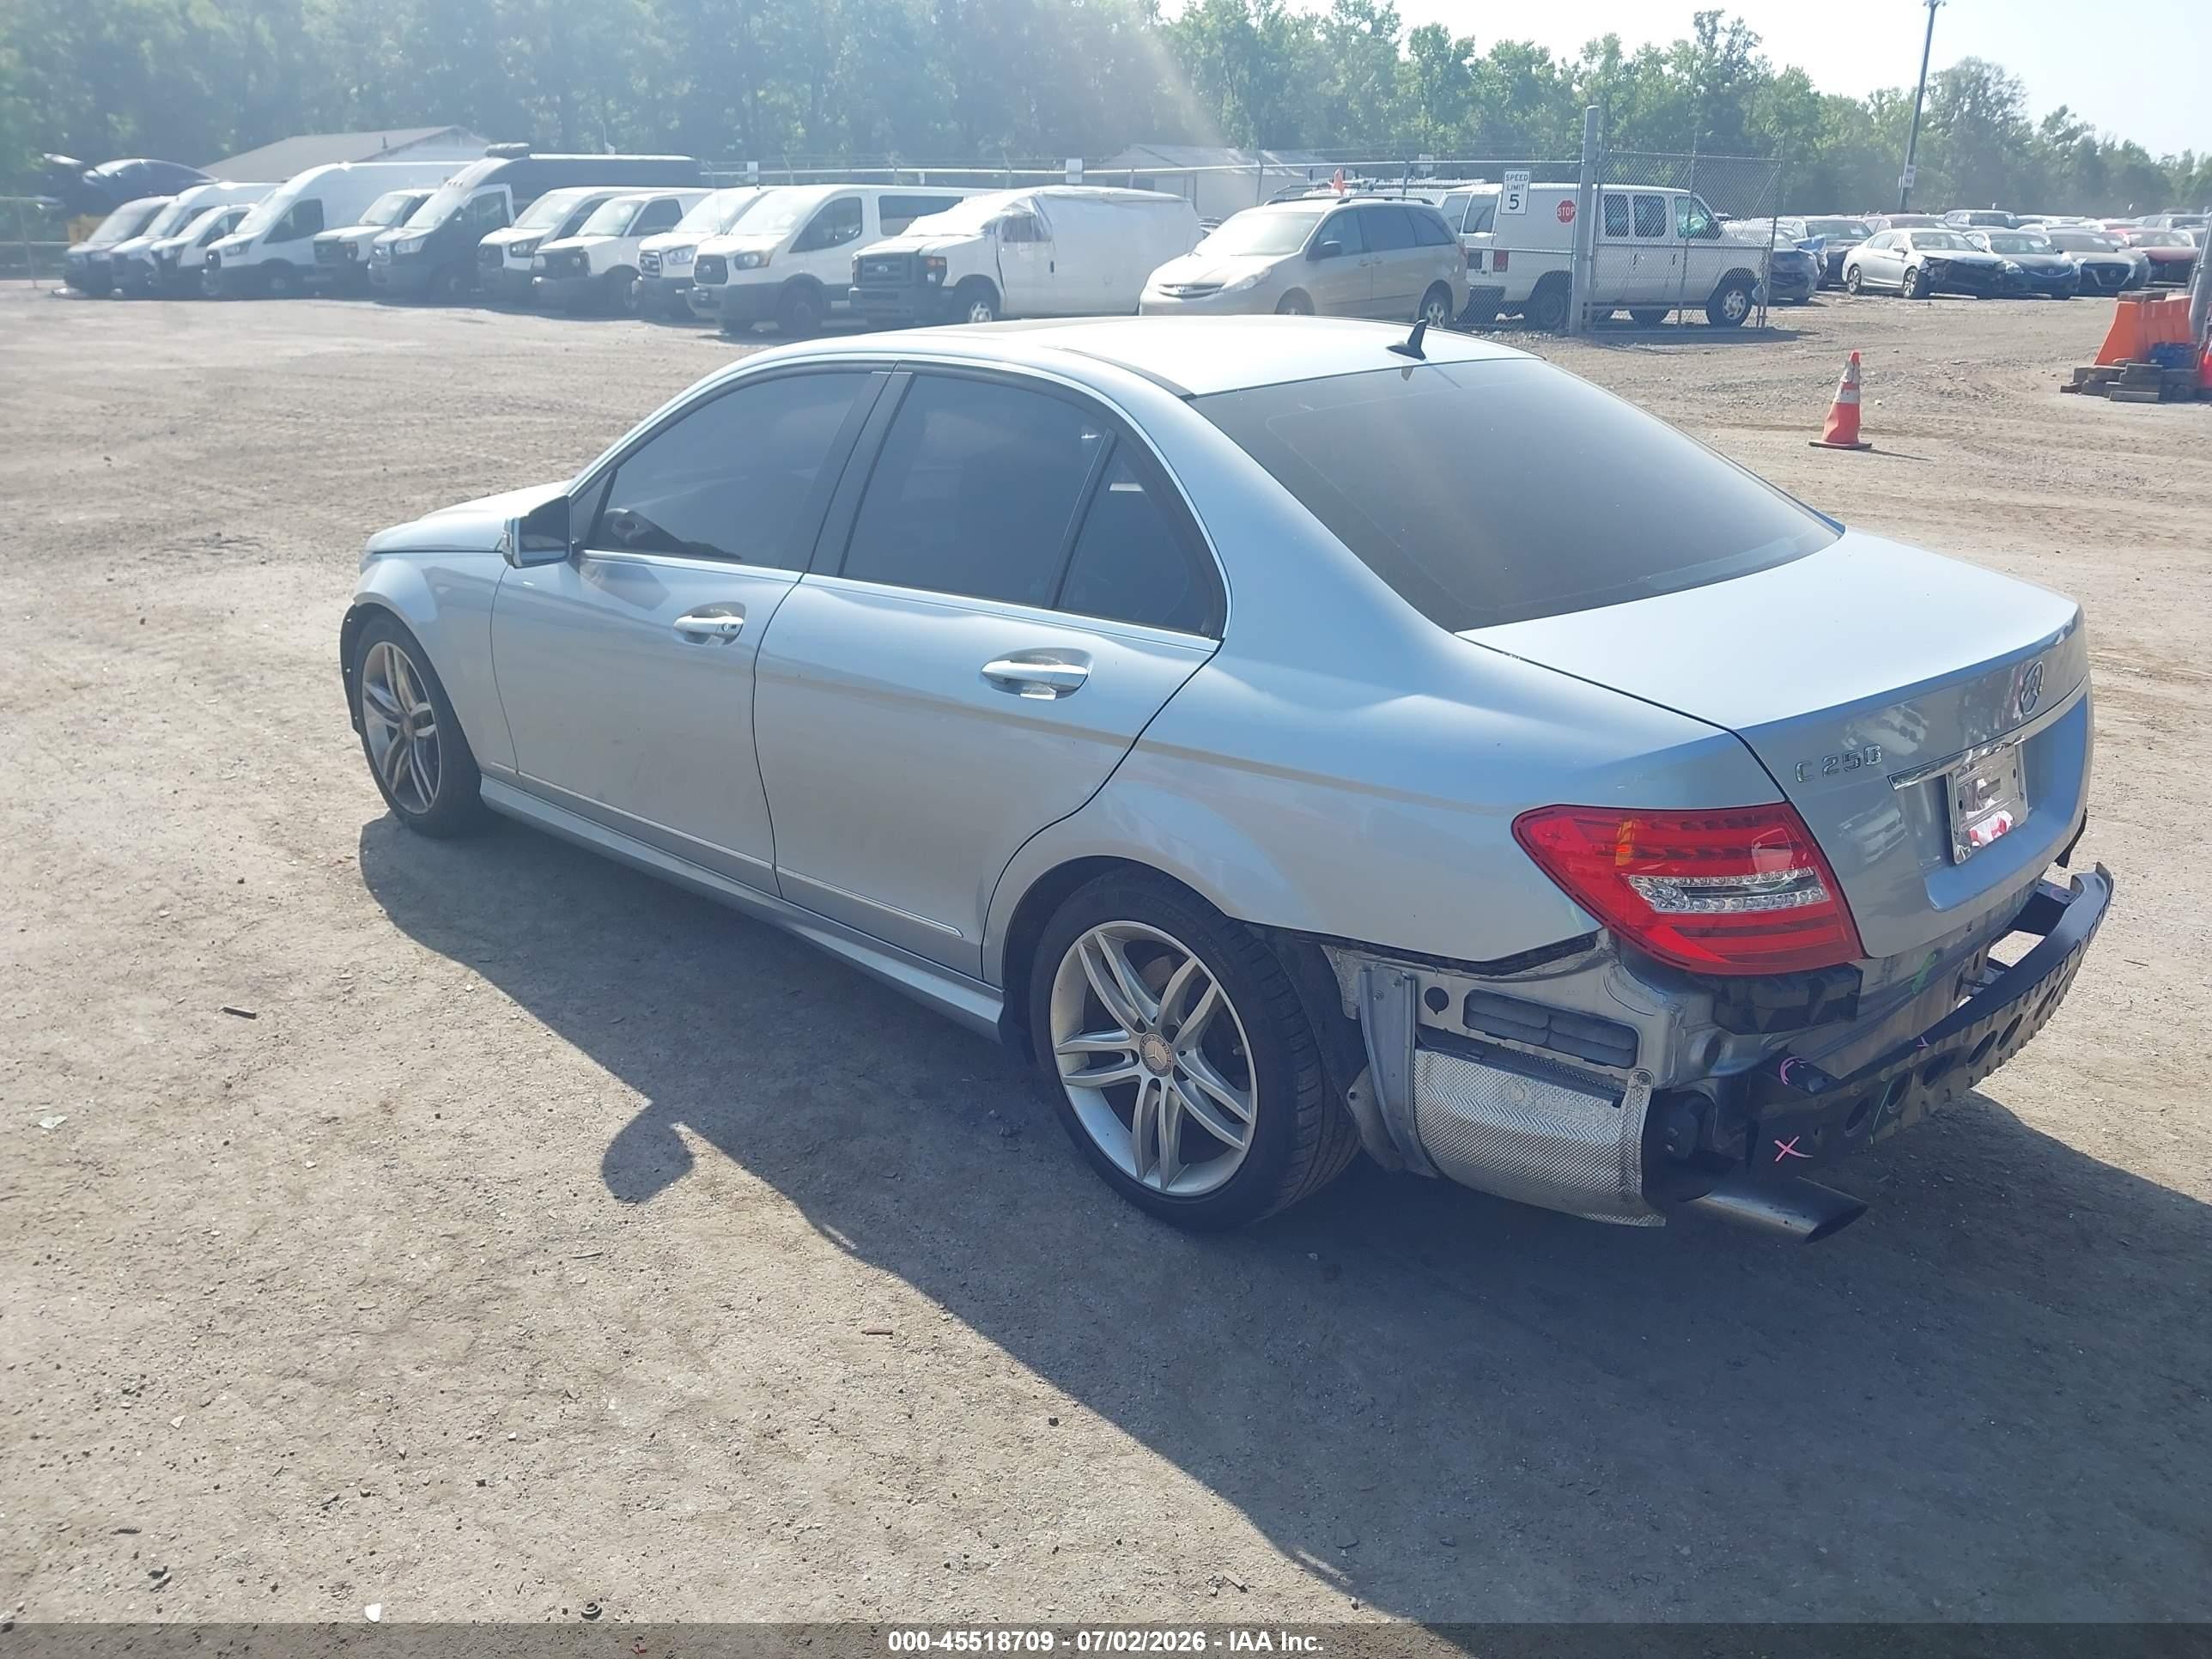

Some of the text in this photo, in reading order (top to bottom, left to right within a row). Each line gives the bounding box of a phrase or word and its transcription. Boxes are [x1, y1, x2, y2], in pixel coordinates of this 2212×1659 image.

[1509, 193, 1519, 210] 5
[1557, 207, 1576, 216] STOP
[1796, 744, 1882, 783] C 250
